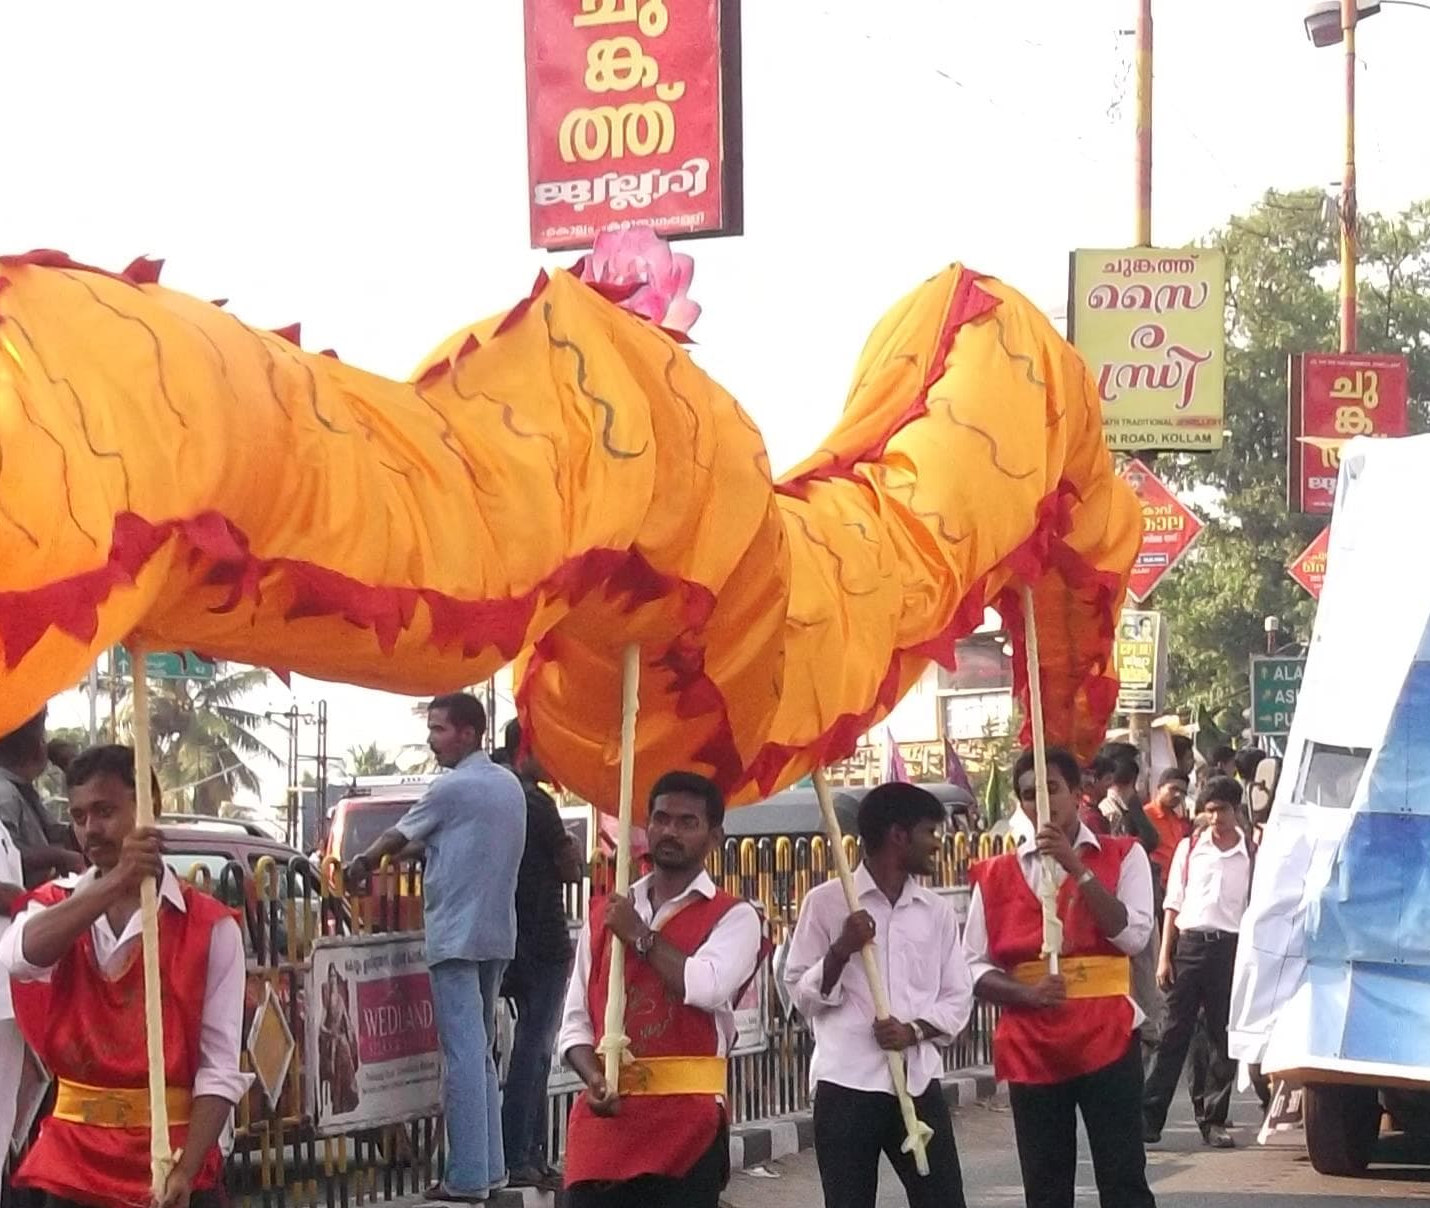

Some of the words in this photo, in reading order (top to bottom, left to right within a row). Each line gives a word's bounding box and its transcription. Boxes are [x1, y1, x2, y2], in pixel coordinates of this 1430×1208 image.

[1102, 254, 1199, 278] ചുങ്കത്ത്
[1121, 433, 1158, 444] ROAD,
[1162, 432, 1212, 444] KOLLAM
[1273, 665, 1303, 681] ALA
[364, 1000, 433, 1036] WEDLAND
